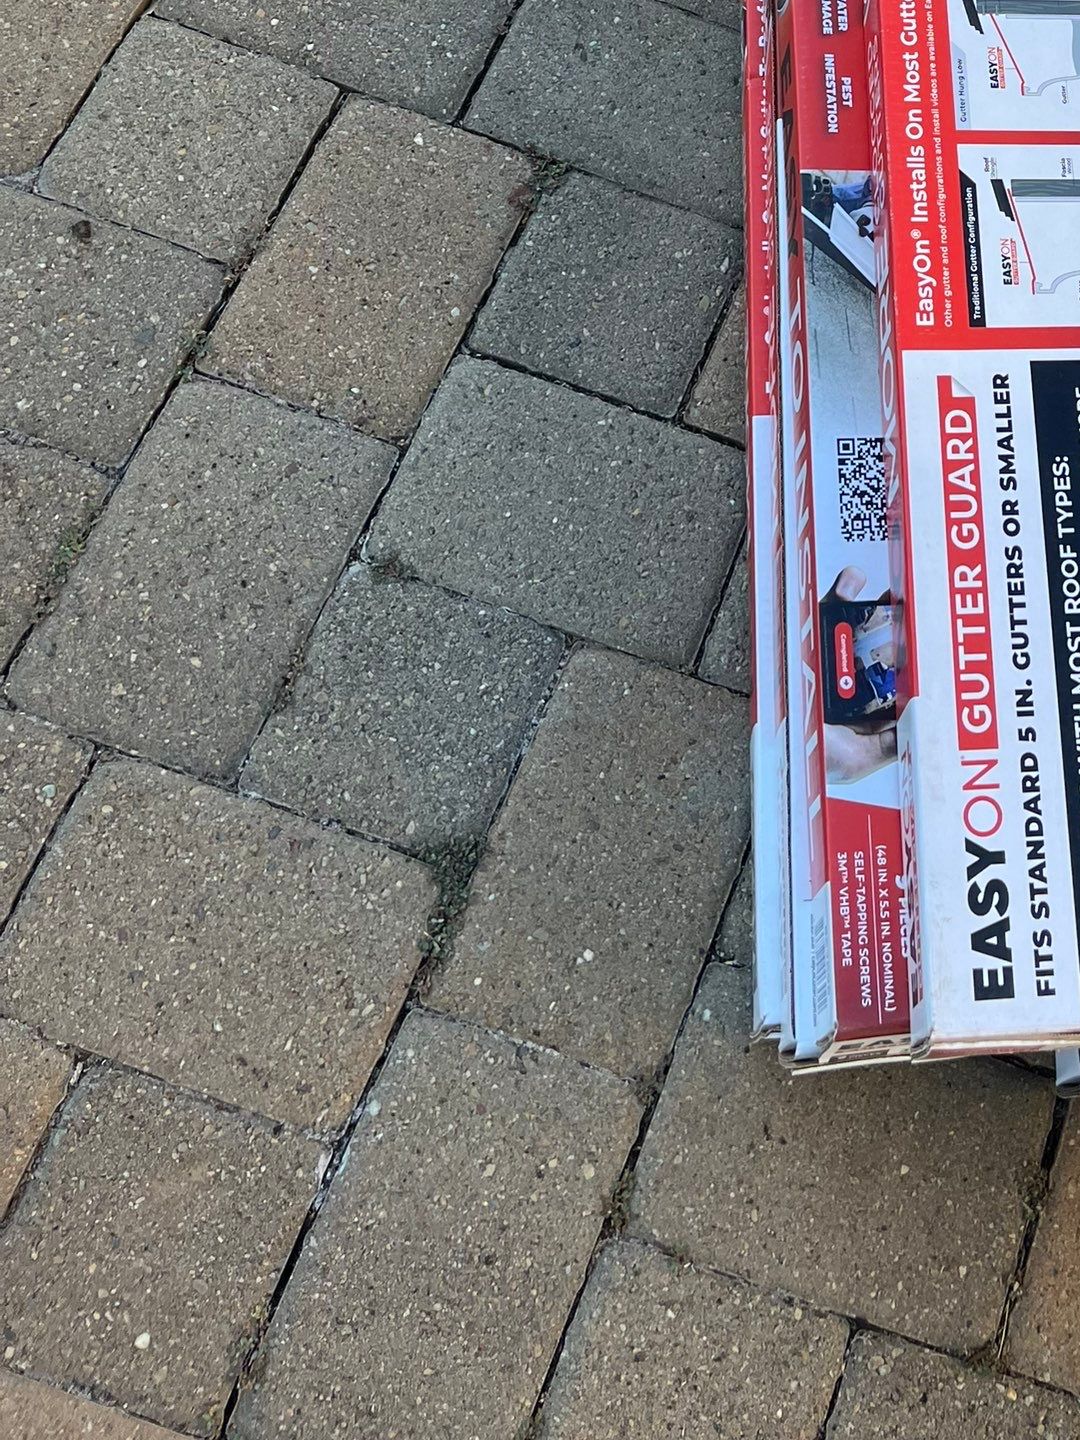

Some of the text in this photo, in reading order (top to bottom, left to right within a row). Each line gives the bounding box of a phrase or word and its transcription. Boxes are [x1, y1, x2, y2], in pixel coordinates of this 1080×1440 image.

[925, 11, 935, 22] on
[926, 23, 937, 60] available
[901, 51, 921, 101] Most
[928, 61, 938, 76] are
[957, 75, 966, 95] Hung
[822, 52, 839, 134] INFESTATION
[839, 75, 853, 108] PEST
[929, 78, 940, 106] videos
[958, 98, 966, 122] Gutter
[904, 109, 923, 139] On
[931, 107, 942, 134] install
[932, 136, 943, 154] and
[905, 145, 928, 221] Installs
[934, 155, 948, 222] configurations
[938, 223, 949, 242] roof
[939, 245, 950, 263] and
[964, 187, 980, 318] Traditional Gutter Configuration
[940, 265, 952, 296] gutter
[942, 297, 954, 326] Other
[780, 44, 820, 862] EASY TO INSTALL
[1051, 456, 1075, 538] TYPES:
[943, 409, 992, 733] GUTTER GUARD
[839, 633, 848, 672] Completed
[991, 373, 1055, 996] FITS STANDARD 5 IN. GUTTERS OR SMALLER
[959, 759, 1015, 1000] EASYON
[853, 851, 871, 1007] SELF-TAPPING SCREWS
[875, 845, 896, 1011] (48 IN. X 5.5 IN. NOMINAL)
[841, 930, 853, 967] TAPE
